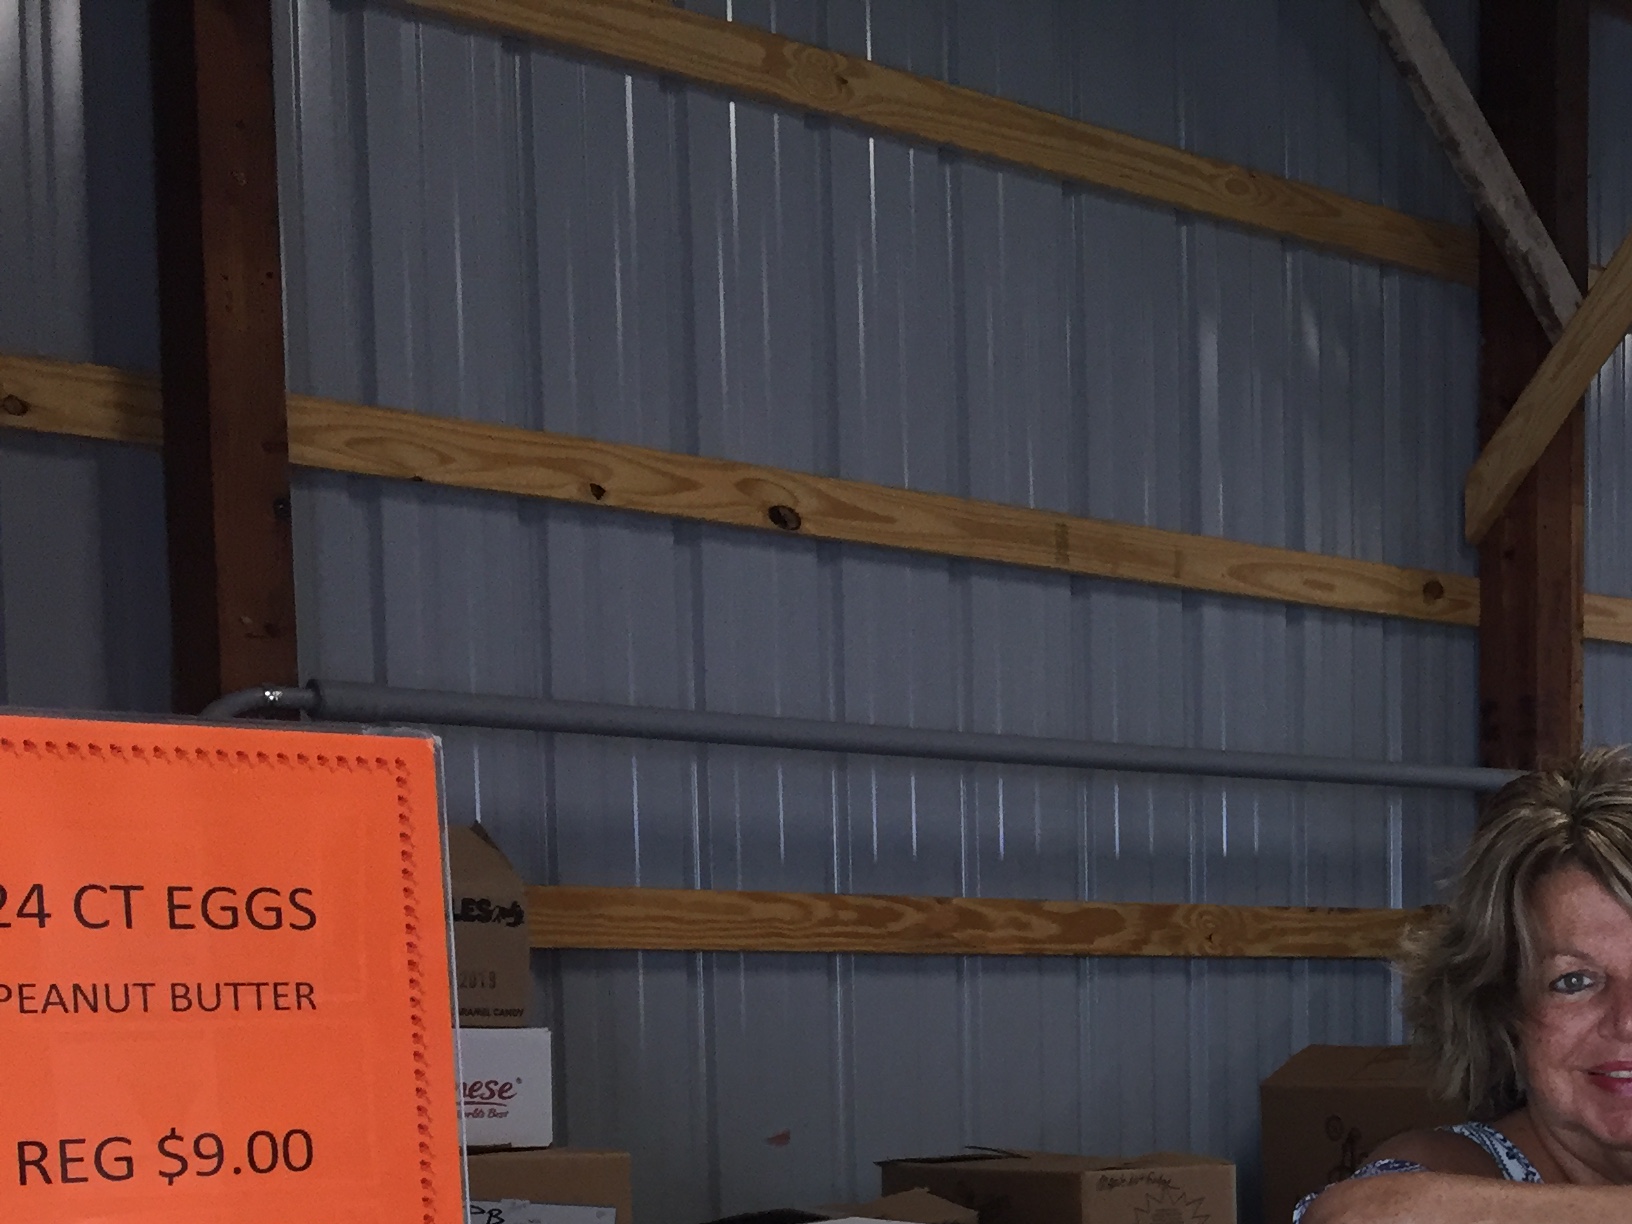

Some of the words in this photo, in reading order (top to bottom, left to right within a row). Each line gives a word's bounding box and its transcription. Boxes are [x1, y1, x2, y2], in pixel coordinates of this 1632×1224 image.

[73, 884, 144, 930] CT
[166, 885, 317, 932] EGGS
[170, 981, 317, 1012] BUTTER
[17, 1136, 134, 1186] REG
[158, 1127, 314, 1187] $9.00
